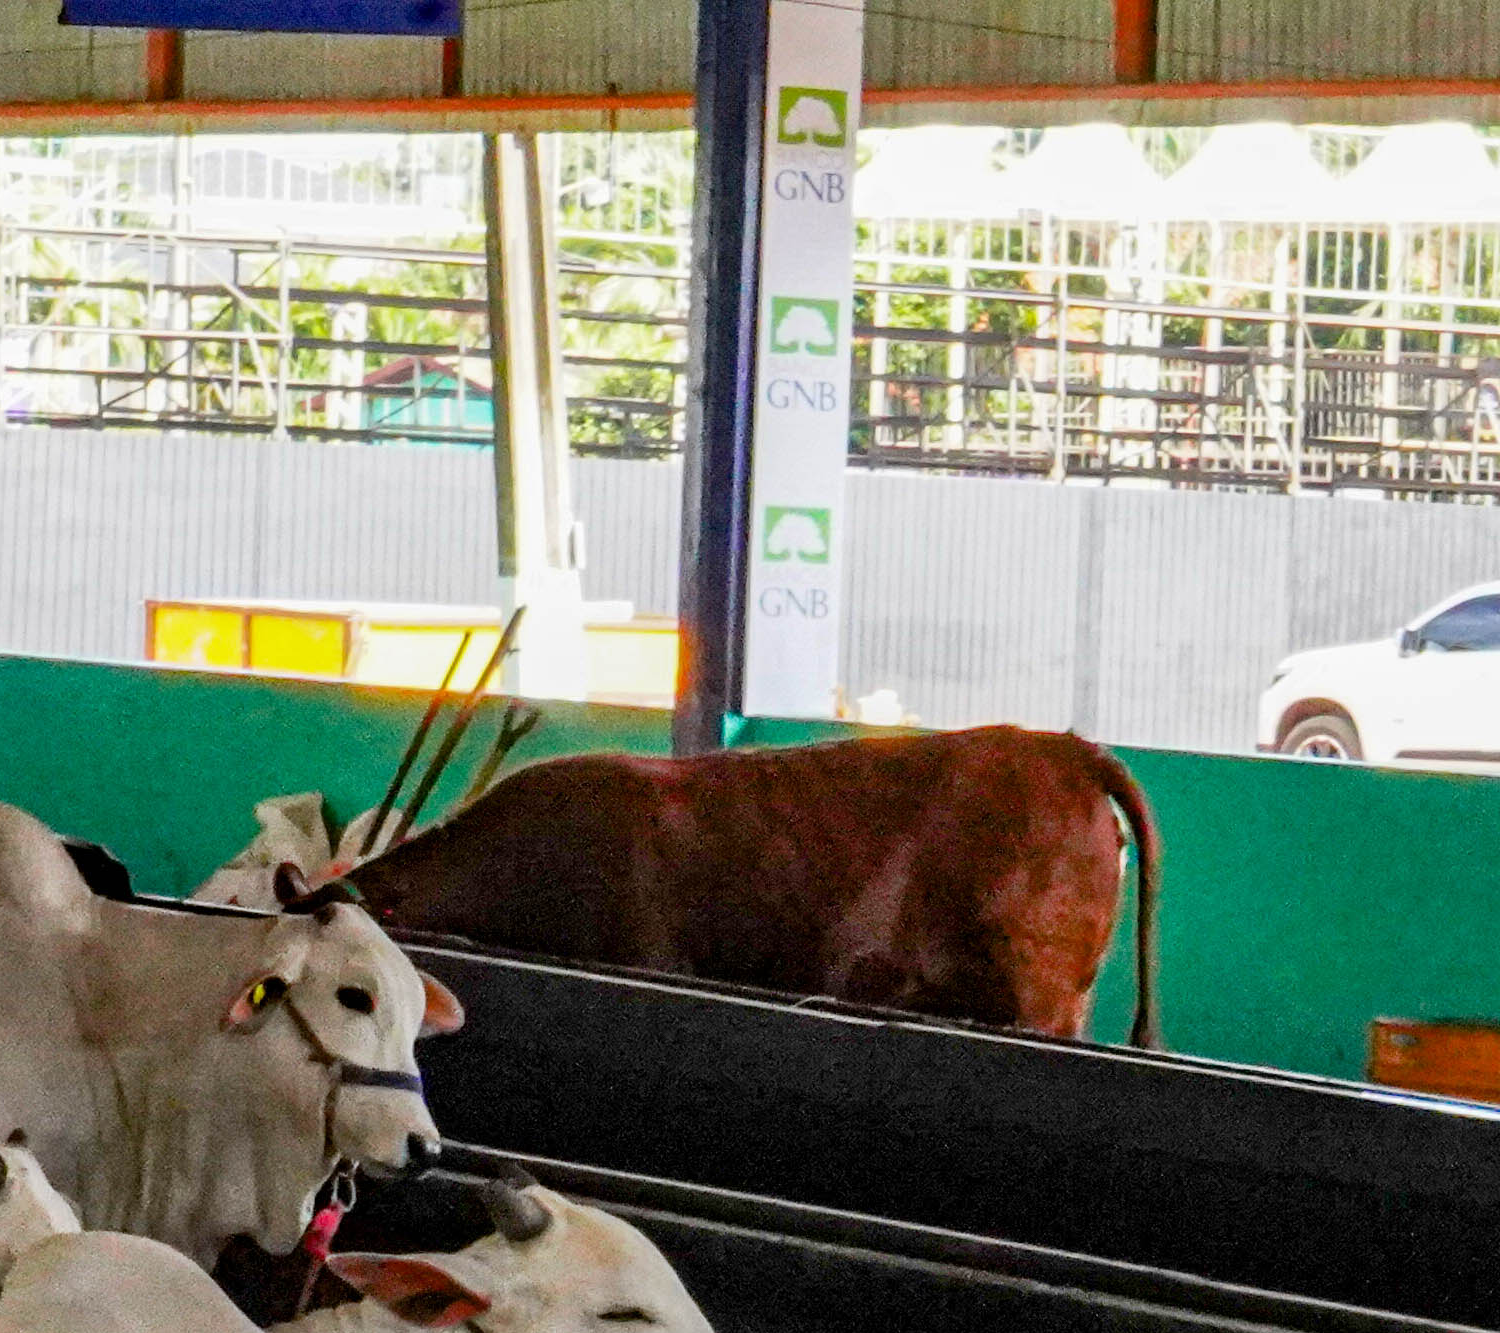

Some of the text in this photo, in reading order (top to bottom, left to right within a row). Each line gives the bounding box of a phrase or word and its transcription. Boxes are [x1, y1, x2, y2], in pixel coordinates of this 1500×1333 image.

[775, 169, 845, 203] GNB
[766, 378, 837, 412] GNB
[759, 586, 829, 619] GNB
